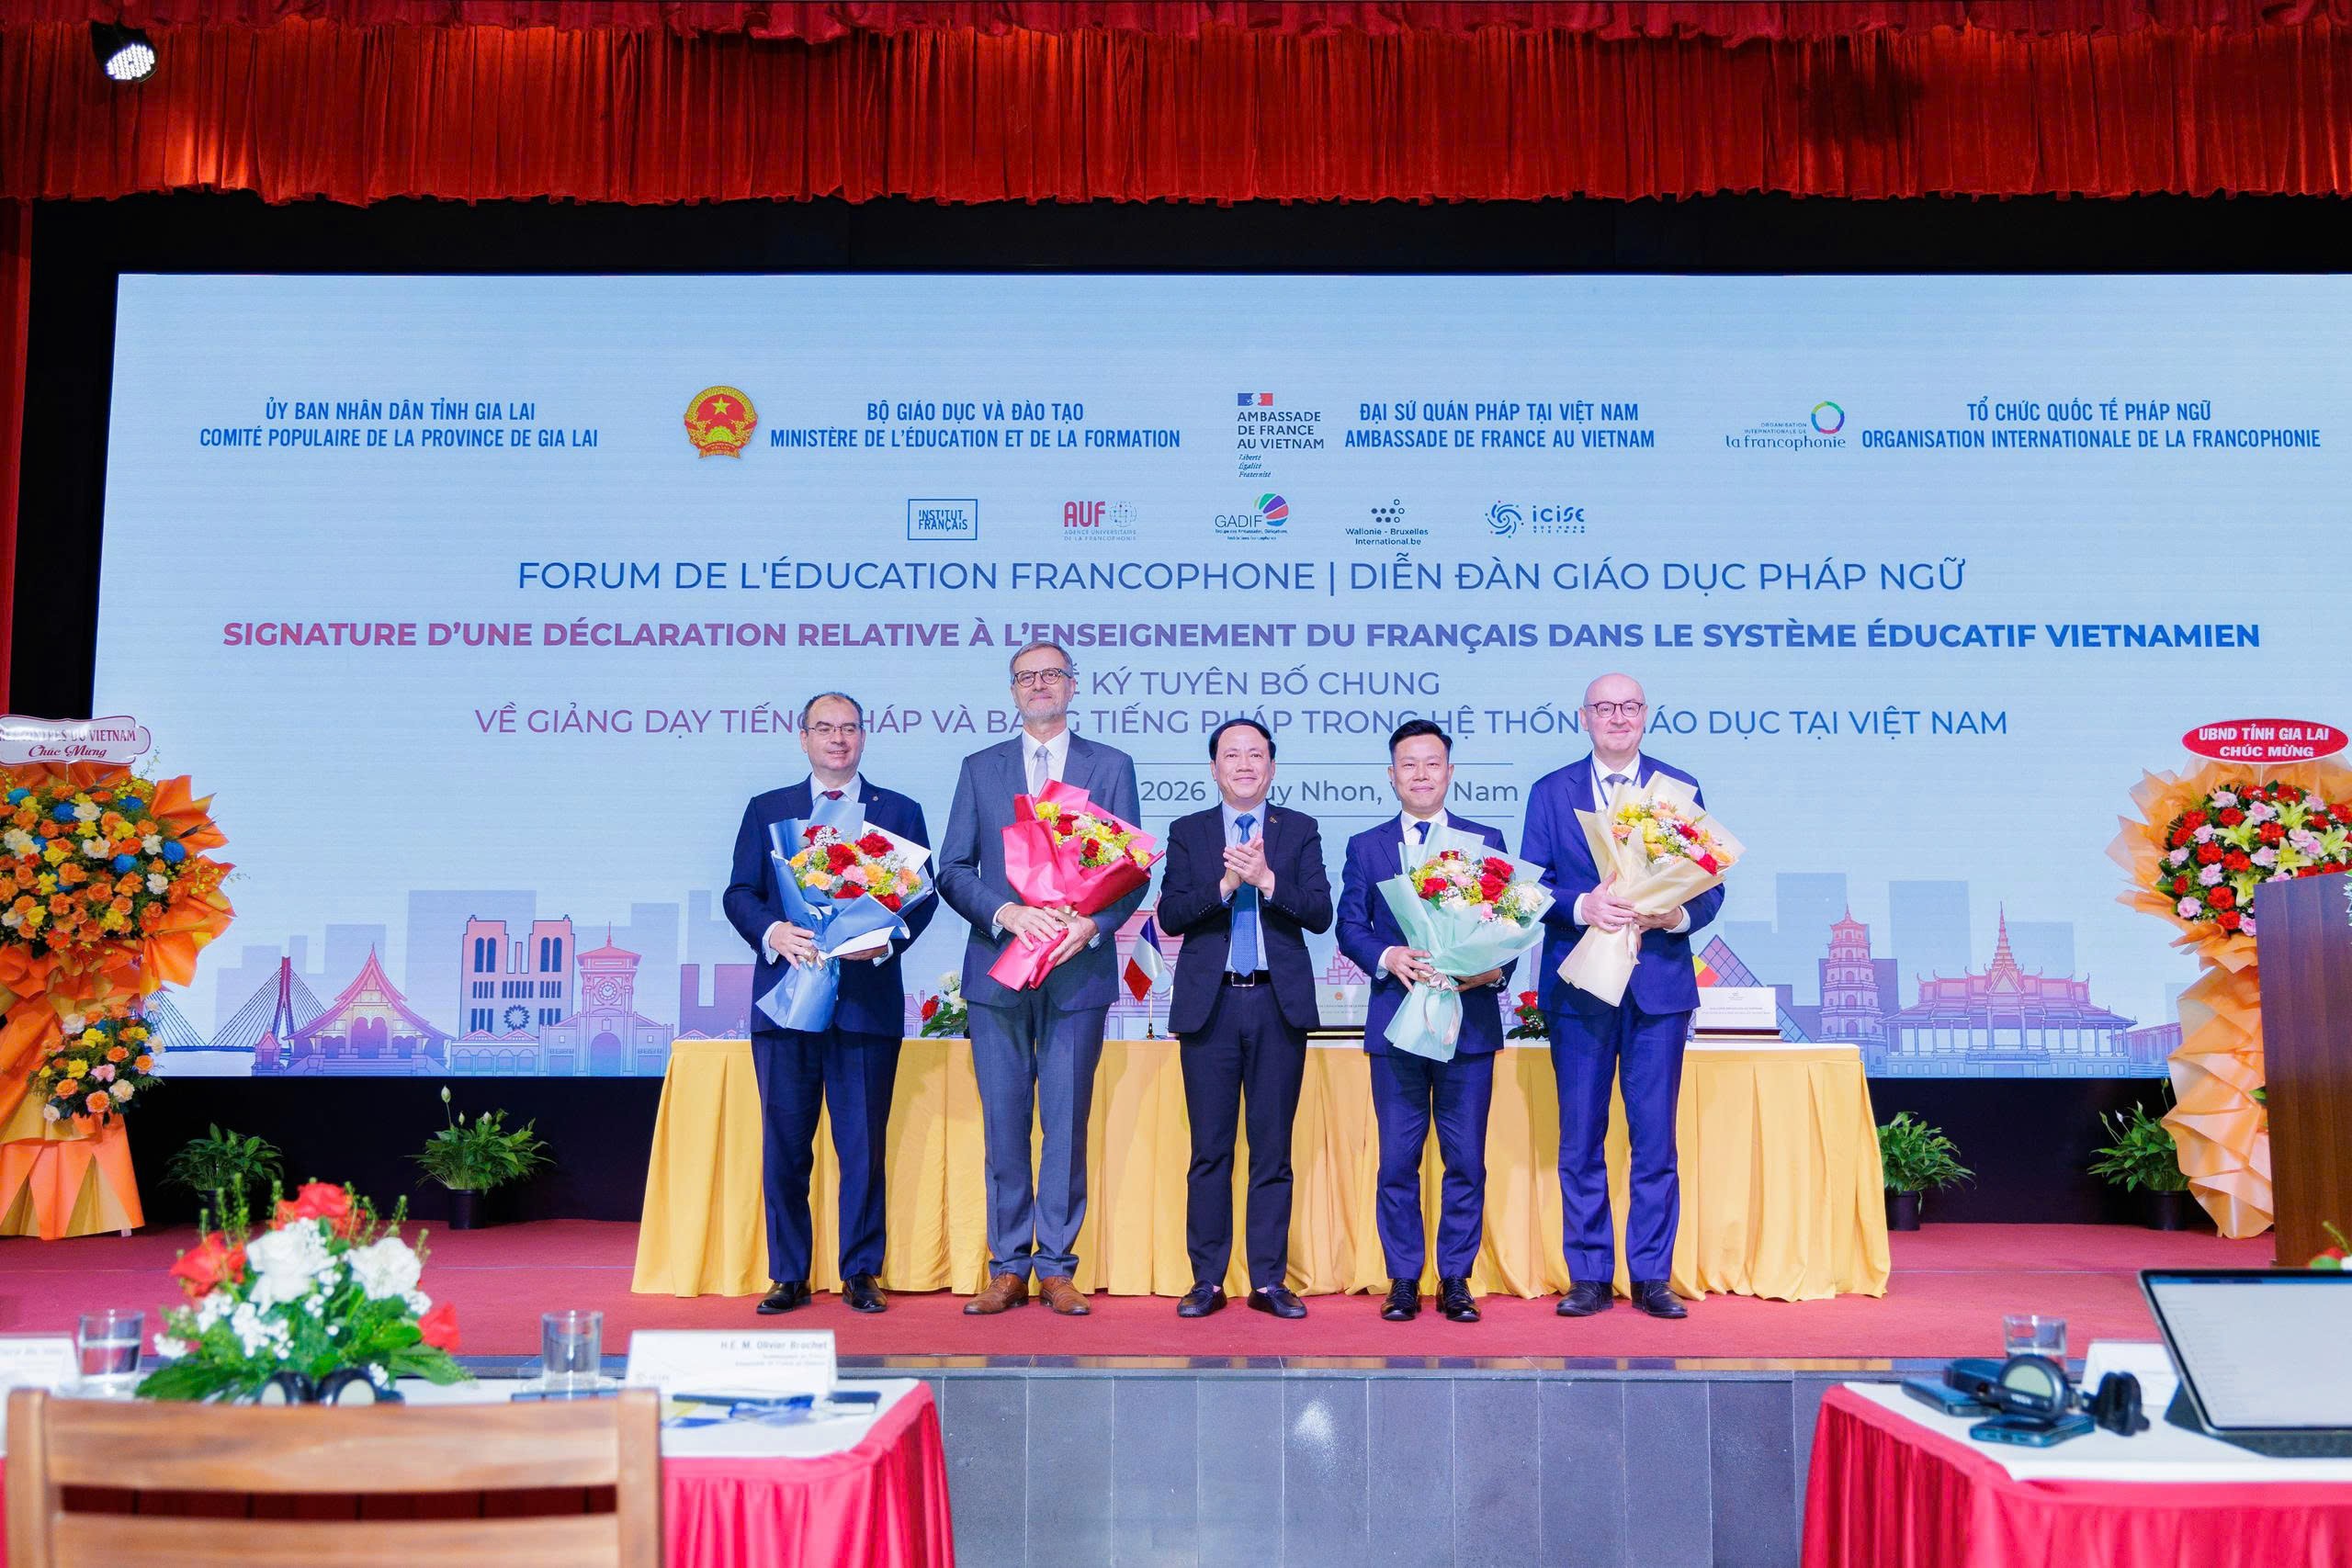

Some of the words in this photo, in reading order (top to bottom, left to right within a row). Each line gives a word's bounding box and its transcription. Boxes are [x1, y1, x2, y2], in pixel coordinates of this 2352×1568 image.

[266, 397, 288, 419] ỦY
[295, 402, 329, 420] BAN
[336, 400, 381, 420] NHÂN
[390, 400, 424, 420] DÂN
[431, 398, 468, 420] TỈNH
[476, 403, 502, 420] GIA
[510, 403, 535, 420] LAI
[867, 400, 888, 423] BỘ
[898, 400, 934, 421] GIÁO
[943, 403, 975, 423] DỤC
[983, 400, 1004, 420] VÀ
[1012, 400, 1045, 421] ĐÀO
[1051, 403, 1083, 424] TẠO
[1238, 412, 1320, 422] AMBASSADE
[1360, 403, 1386, 424] ĐẠI
[1395, 400, 1416, 421] SỨ
[1423, 400, 1467, 422] QUÁN
[1476, 400, 1520, 421] PHÁP
[1526, 403, 1551, 423] TẠI
[1559, 400, 1594, 423] VIỆT
[1601, 404, 1638, 421] NAM
[1967, 396, 1988, 421] TỔ
[1996, 400, 2040, 421] CHỨC
[2048, 398, 2092, 422] QUỐC
[2099, 398, 2118, 421] TẾ
[2125, 400, 2169, 421] PHÁP
[2177, 400, 2211, 421] NGỮ
[200, 425, 262, 446] COMITÉ
[269, 429, 360, 446] POPULAIRE
[368, 429, 388, 446] DE
[395, 429, 414, 446] LA
[422, 429, 503, 446] PROVINCE
[511, 430, 531, 446] DE
[538, 430, 565, 446] GIA
[572, 430, 597, 446] LAI
[771, 426, 857, 446] MINISTÈRE
[865, 430, 885, 446] DE
[892, 426, 998, 447] L’ÉDUCATION
[1006, 430, 1023, 447] ET
[1031, 430, 1050, 447] DE
[1058, 430, 1077, 447] LA
[1085, 430, 1180, 447] FORMATION
[1238, 425, 1255, 434] DE
[1261, 425, 1314, 435] FRANCE
[1345, 430, 1448, 447] AMBASSADE
[1454, 430, 1475, 447] DE
[1482, 430, 1545, 447] FRANCE
[1553, 430, 1574, 447] AU
[1581, 430, 1654, 447] VIETNAM
[1862, 430, 1984, 447] ORGANISATION
[1992, 430, 2131, 447] INTERNATIONALE
[2138, 430, 2158, 447] DE
[2165, 430, 2186, 447] LA
[2193, 430, 2320, 447] FRANCOPHONIE
[1238, 439, 1256, 448] AU
[1261, 439, 1323, 448] VIETNAM
[1726, 435, 1739, 447] la
[1745, 435, 1845, 451] francophonie
[1064, 502, 1105, 527] AUF
[1215, 514, 1262, 528] GADIF
[1345, 527, 1382, 536] Wallonie
[1390, 527, 1429, 536] Bruxelles
[1355, 537, 1421, 546] International.be
[520, 562, 660, 589] FORUM
[676, 563, 727, 589] DE
[741, 556, 996, 589] L'ÉDUCATION
[1012, 563, 1315, 589] FRANCOPHONE
[1351, 553, 1441, 589] DIỄN
[1455, 557, 1539, 589] ĐÀN
[1554, 557, 1648, 590] GIÁO
[1664, 563, 1746, 596] DỤC
[1760, 557, 1866, 590] PHÁP
[1881, 557, 1965, 590] NGỮ
[223, 623, 416, 646] SIGNATURE
[428, 622, 532, 646] D’UNE
[544, 617, 786, 647] DÉCLARATION
[798, 624, 959, 646] RELATIVE
[968, 617, 994, 646] À
[1005, 623, 1296, 647] L’ENSEIGNEMENT
[1307, 625, 1354, 647] DU
[1367, 624, 1538, 653] FRANÇAIS
[1549, 624, 1644, 647] DANS
[1655, 625, 1692, 647] LE
[1703, 618, 1856, 647] SYSTÈME
[1868, 618, 2036, 647] ÉDUCATIF
[2045, 625, 2259, 647] VIETNAMIEN
[1093, 666, 1132, 694] KÝ
[1140, 667, 1247, 694] TUYÊN
[1261, 664, 1307, 694] BỐ
[1319, 672, 1439, 694] CHUNG
[475, 702, 516, 732] VỀ
[528, 702, 632, 733] GIẢNG
[646, 710, 711, 739] DẠY
[863, 704, 922, 734] HÁP
[932, 705, 976, 734] VÀ
[1091, 703, 1188, 733] TIẾNG
[1431, 705, 1475, 739] HỆ
[1485, 703, 1579, 734] THỐN
[1710, 711, 1780, 739] DỤC
[1789, 711, 1838, 739] TẠI
[1849, 705, 1920, 739] VIỆT
[1932, 711, 2007, 734] NAM
[89, 729, 136, 741] VIETNAM
[2199, 728, 2237, 740] UBND
[2242, 724, 2275, 740] TỈNH
[2278, 728, 2303, 740] GIA
[2307, 728, 2329, 740] LAI
[2220, 744, 2264, 757] CHÚC
[2267, 744, 2314, 757] MỪNG
[1141, 782, 1205, 801] 2026
[1265, 785, 1293, 806] uy
[1303, 781, 1382, 805] Nhon,
[1454, 782, 1518, 801] Nam
